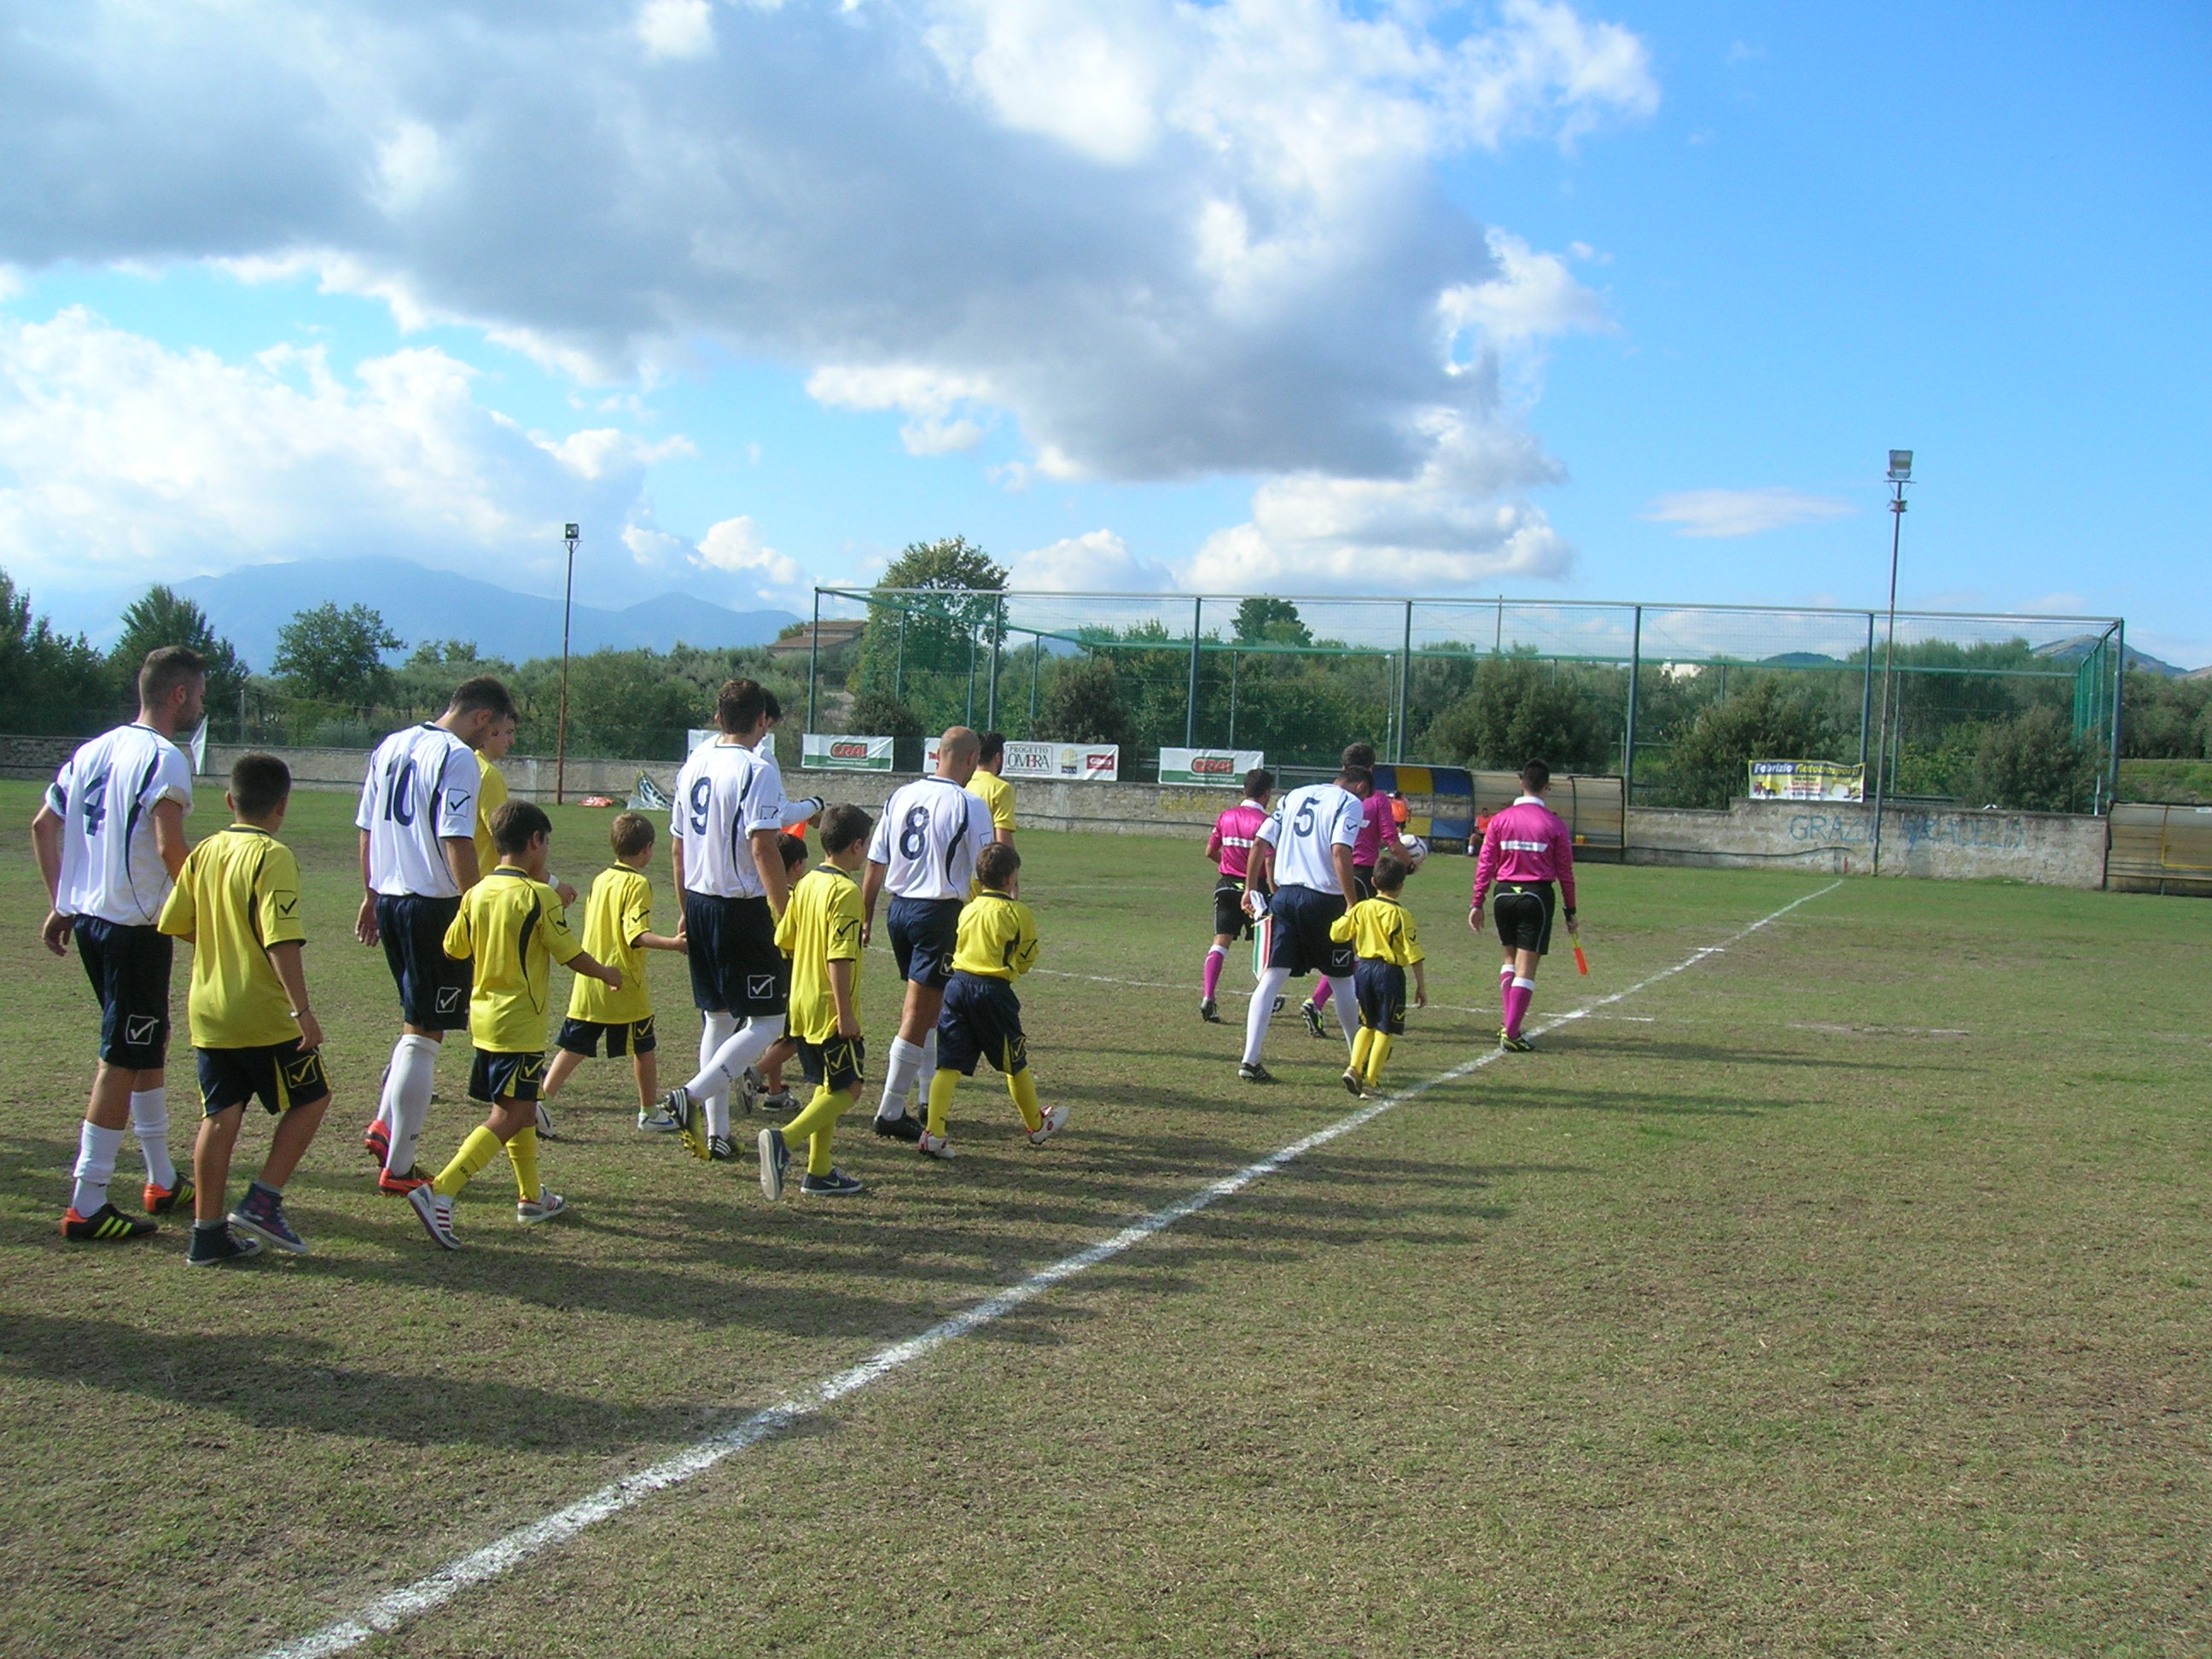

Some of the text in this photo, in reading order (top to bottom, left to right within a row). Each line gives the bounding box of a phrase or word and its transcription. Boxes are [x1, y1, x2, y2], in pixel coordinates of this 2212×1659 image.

[831, 744, 868, 758] CRAI
[1007, 752, 1050, 769] OMBRA
[1009, 746, 1049, 754] PROGETTO
[1192, 758, 1233, 773] CRAI
[1754, 763, 1793, 774] Fabrizio
[83, 762, 113, 836] 4
[384, 754, 417, 827] 10
[690, 777, 712, 835] 9
[1294, 796, 1321, 838] 5
[899, 806, 929, 860] 8
